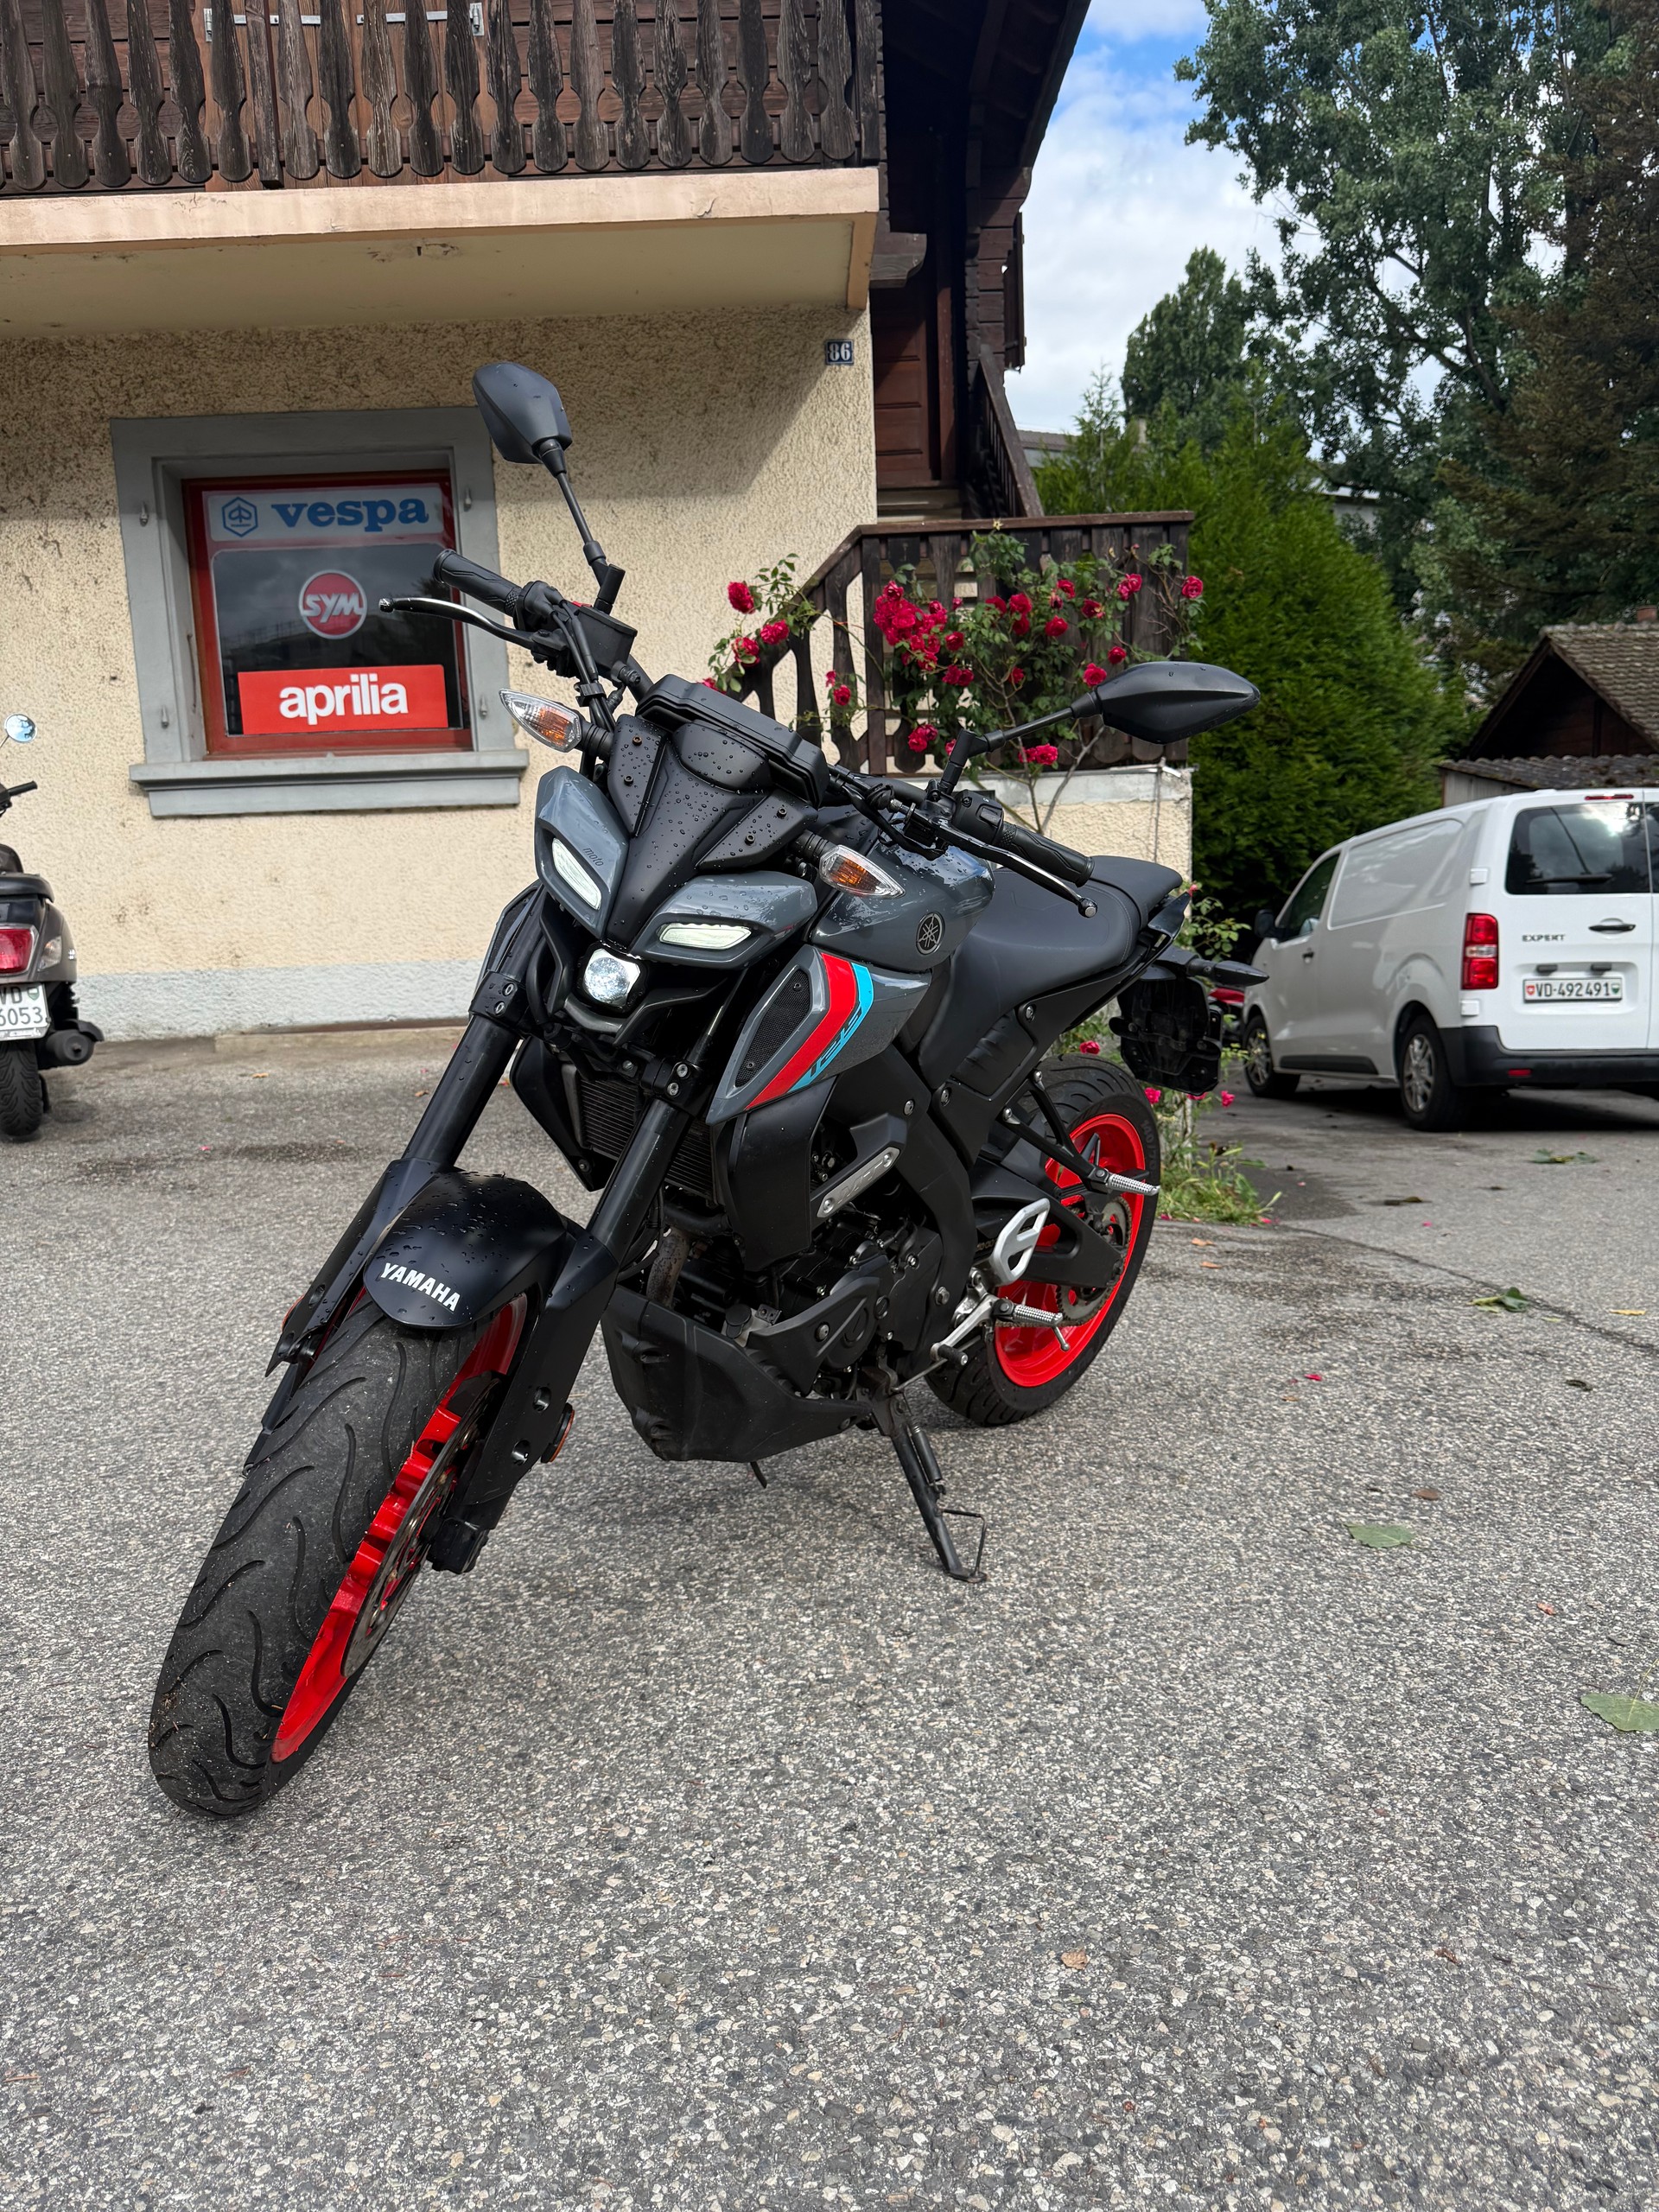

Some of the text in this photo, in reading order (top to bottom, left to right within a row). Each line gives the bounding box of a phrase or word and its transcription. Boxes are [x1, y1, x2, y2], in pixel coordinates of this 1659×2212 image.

[830, 342, 851, 361] 86
[271, 498, 429, 532] vespa
[302, 592, 365, 623] SYM
[279, 673, 409, 725] aprilia
[582, 848, 604, 867] moto
[1522, 934, 1566, 943] EXPERT
[0, 986, 22, 1005] VD
[0, 1006, 43, 1027] 6053
[380, 1262, 461, 1312] YAMAHA
